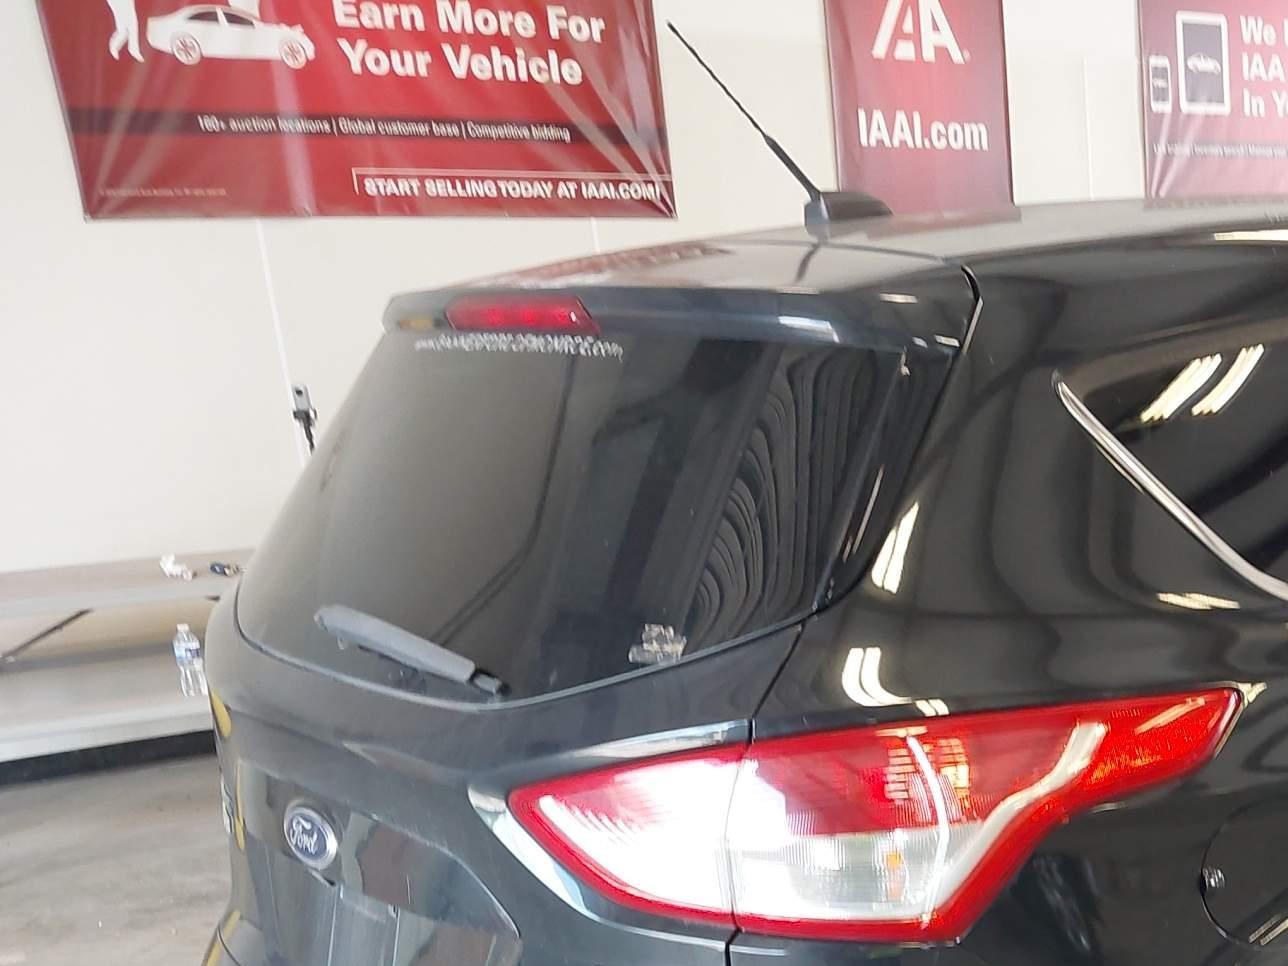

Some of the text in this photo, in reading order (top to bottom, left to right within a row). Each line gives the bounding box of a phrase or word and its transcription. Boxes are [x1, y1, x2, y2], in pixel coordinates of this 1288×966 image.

[332, 0, 606, 43] Earn More For
[1239, 15, 1277, 46] We
[336, 37, 584, 85] Your Vehicle
[1241, 52, 1286, 82] IAA
[1243, 88, 1266, 117] In
[228, 116, 276, 133] auction
[277, 116, 332, 134] locations
[339, 117, 376, 135] Global
[377, 119, 431, 136] customer
[431, 120, 460, 137] base
[467, 121, 530, 141] Competitive
[530, 125, 571, 143] bidding
[857, 107, 989, 151] IAAI.com
[364, 177, 421, 197] START
[425, 178, 498, 198] SELLING
[497, 180, 553, 199] TODAY
[557, 181, 578, 199] AT
[289, 815, 320, 856] Ford
